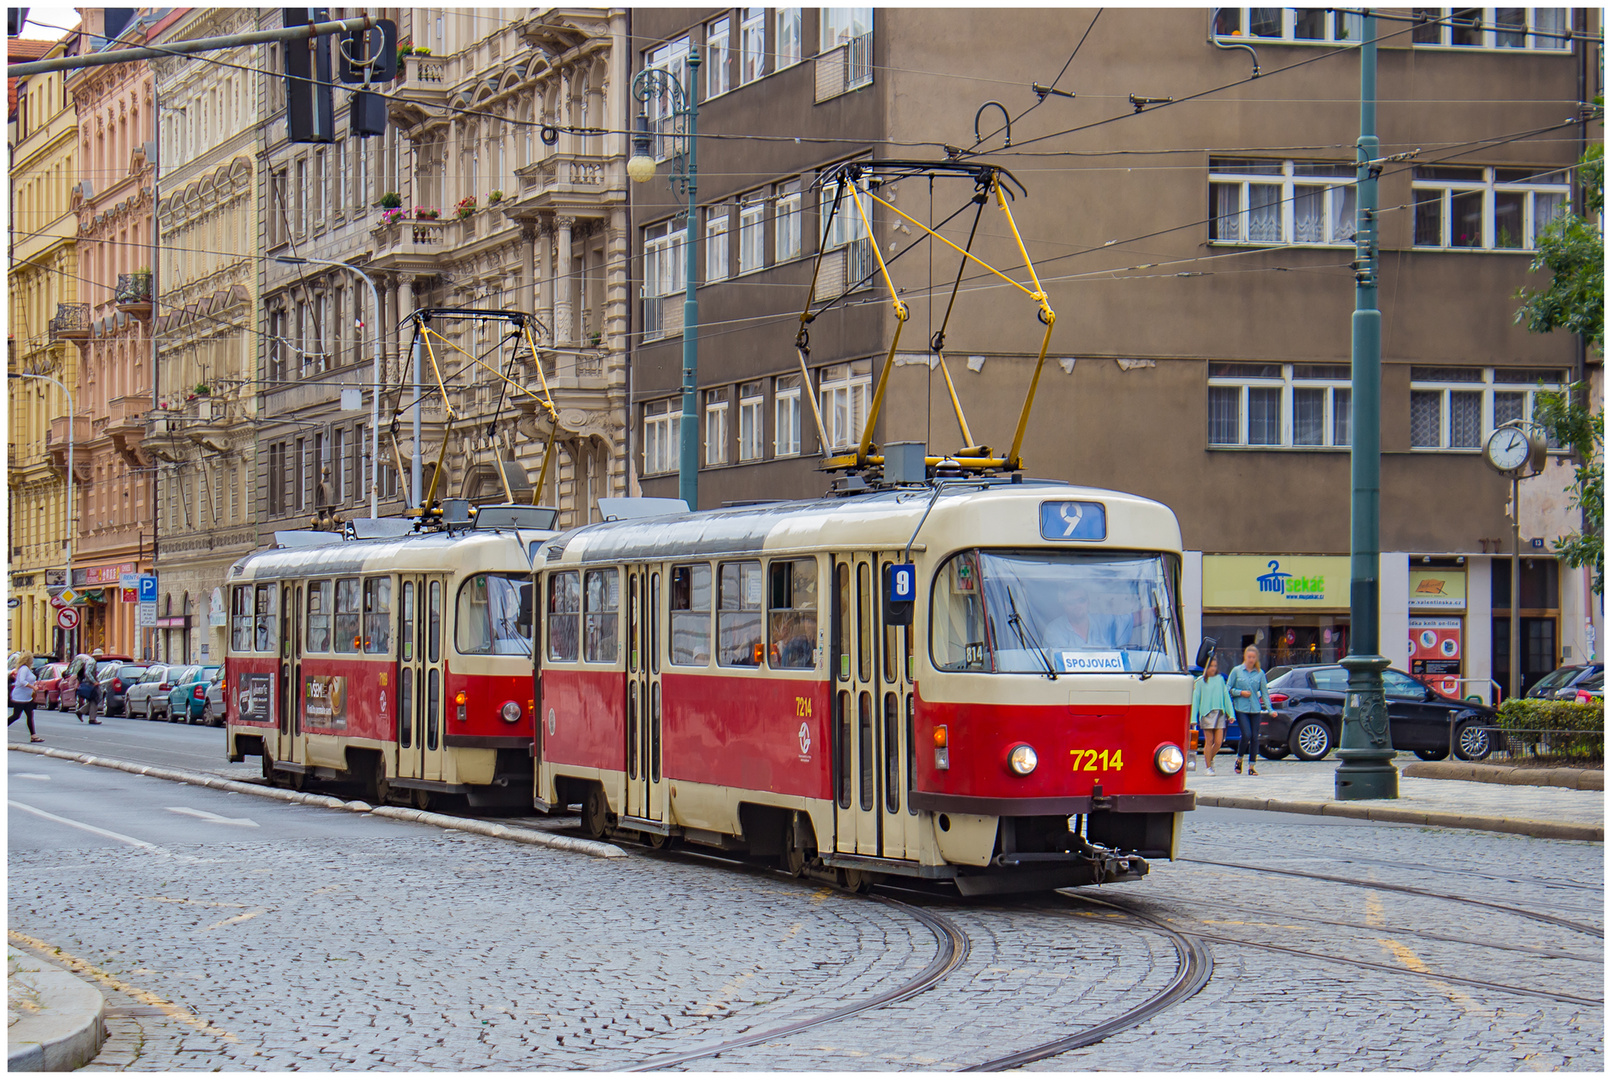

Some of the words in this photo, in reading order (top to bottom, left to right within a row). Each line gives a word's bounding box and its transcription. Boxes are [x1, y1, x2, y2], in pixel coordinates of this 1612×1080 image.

[1060, 501, 1083, 536] 9
[143, 579, 154, 594] P
[896, 570, 909, 595] 9
[966, 645, 983, 662] 814
[1065, 656, 1122, 668] SPOJOVACÍ
[795, 696, 812, 717] 7214
[1069, 749, 1124, 771] 7214
